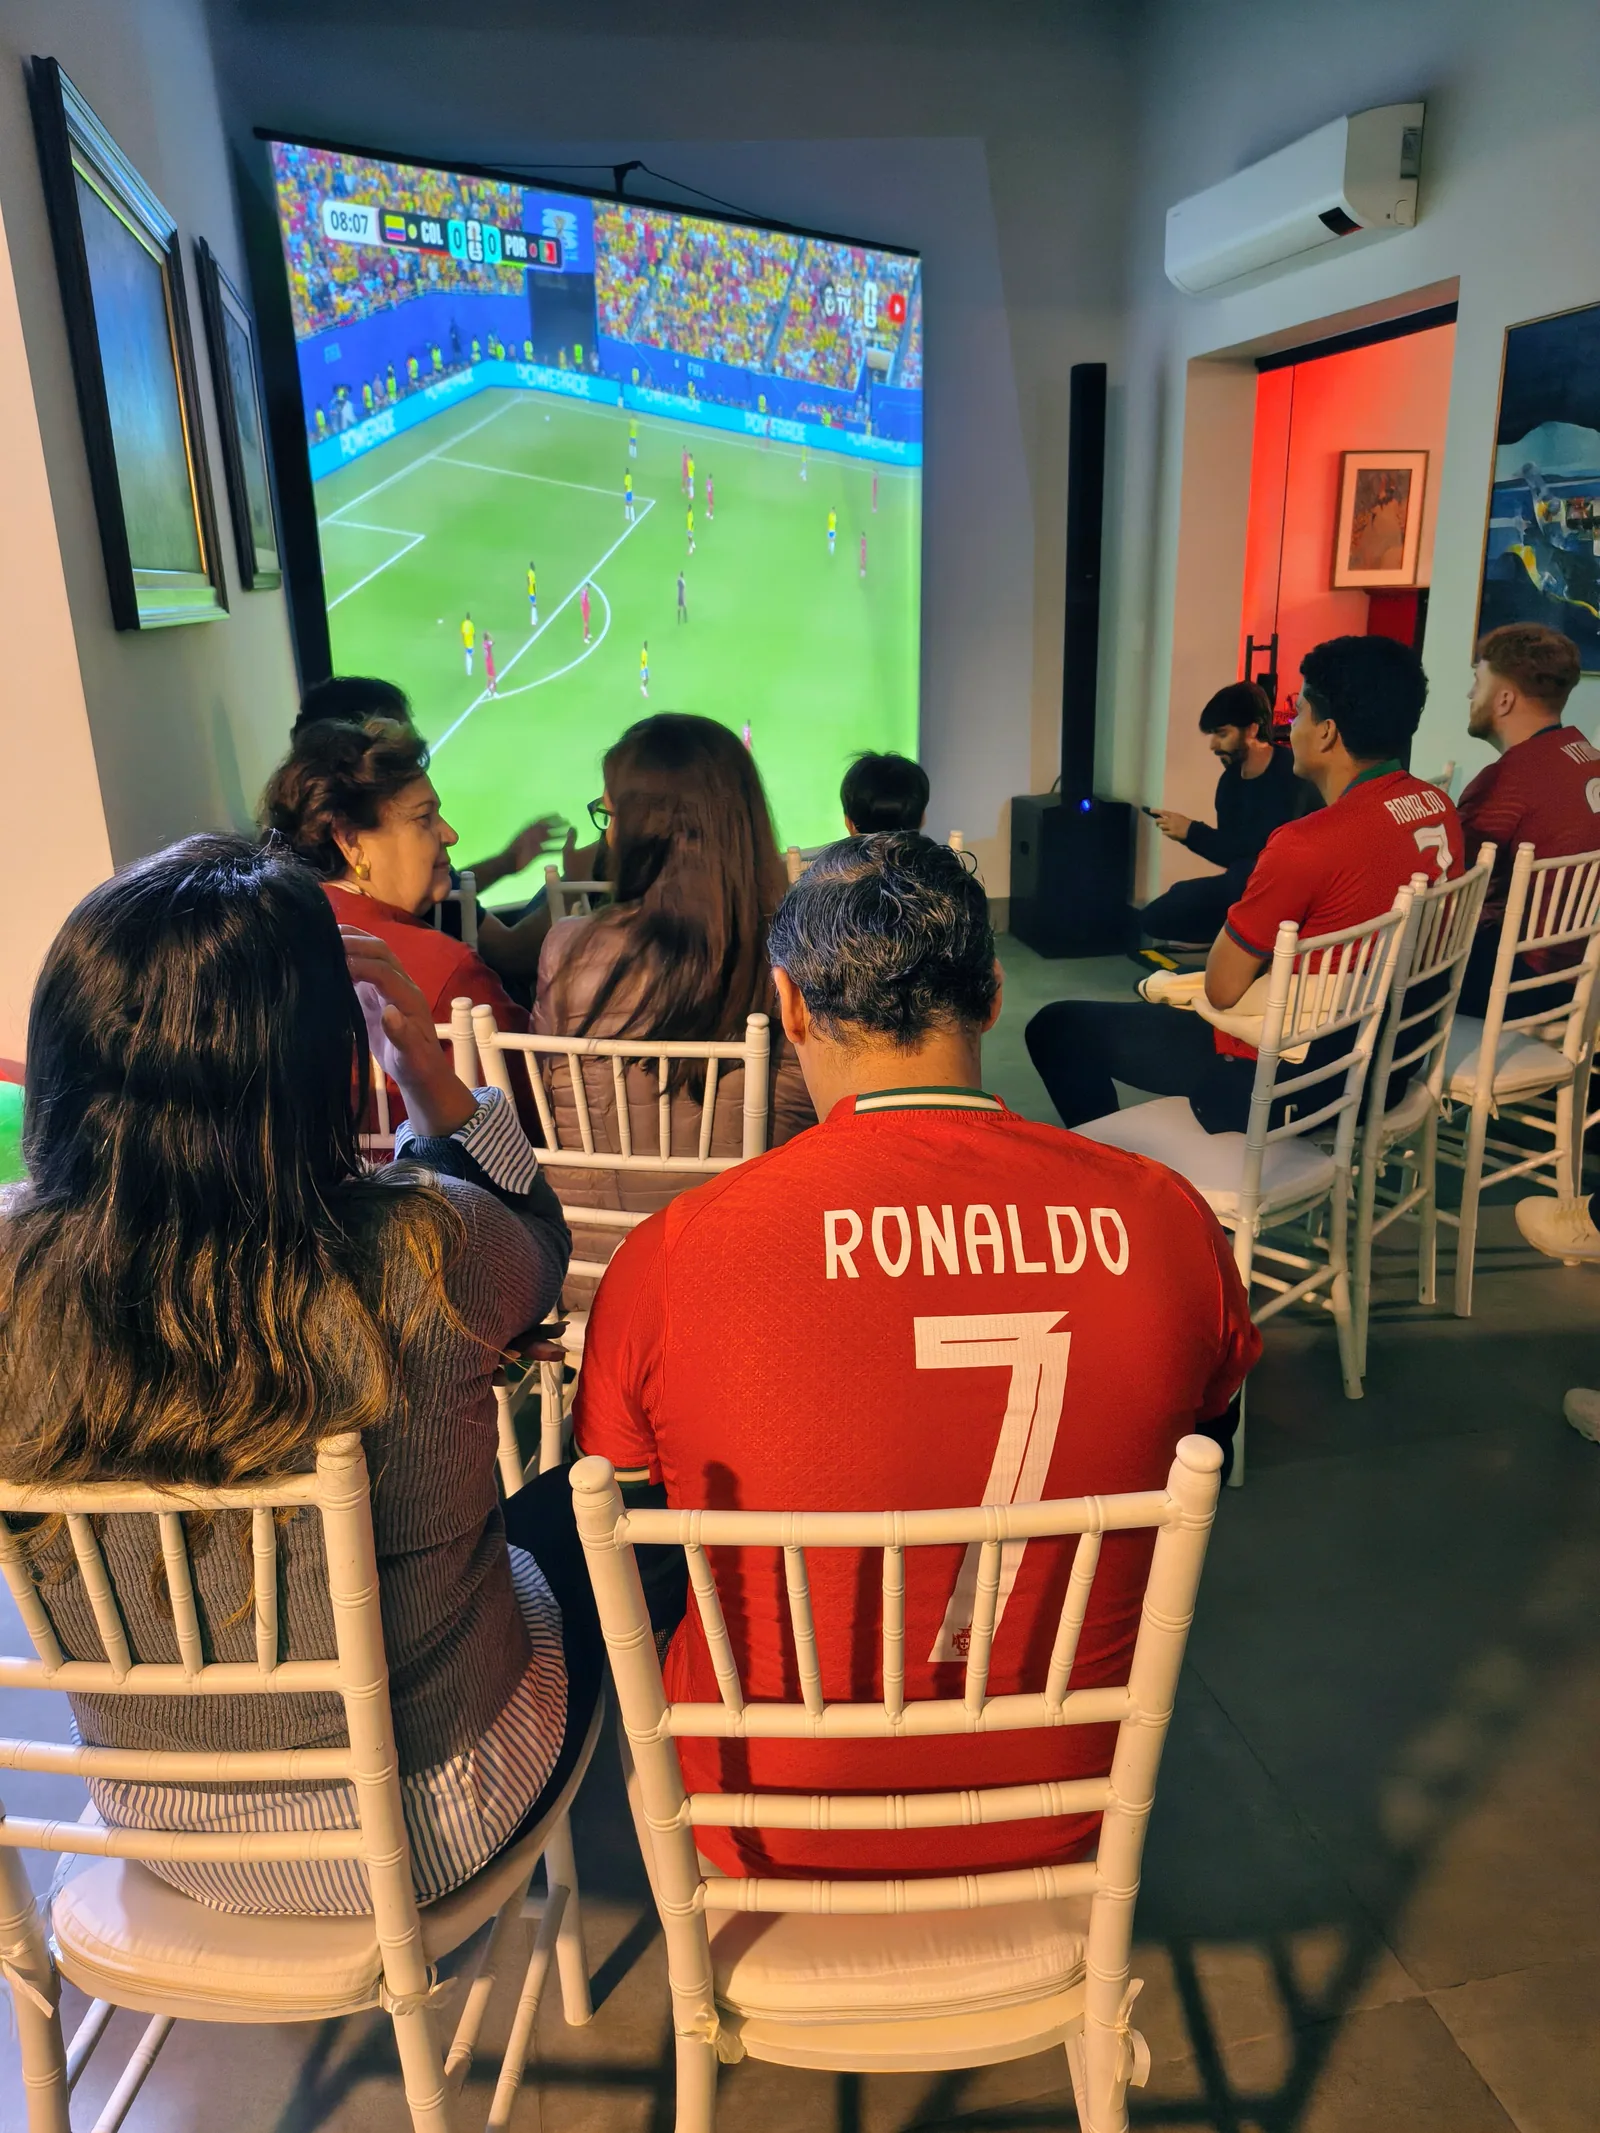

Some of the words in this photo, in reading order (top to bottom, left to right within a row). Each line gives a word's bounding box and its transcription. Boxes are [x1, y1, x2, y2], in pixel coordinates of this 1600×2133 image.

[330, 210, 368, 235] 08:07
[420, 220, 444, 246] COL
[454, 227, 464, 249] 0
[488, 232, 498, 255] 0
[504, 233, 528, 259] POR
[1383, 790, 1447, 826] RONALDO
[1413, 823, 1453, 887] 7
[824, 1203, 1130, 1280] RONALDO
[912, 1310, 1072, 1663] 7
